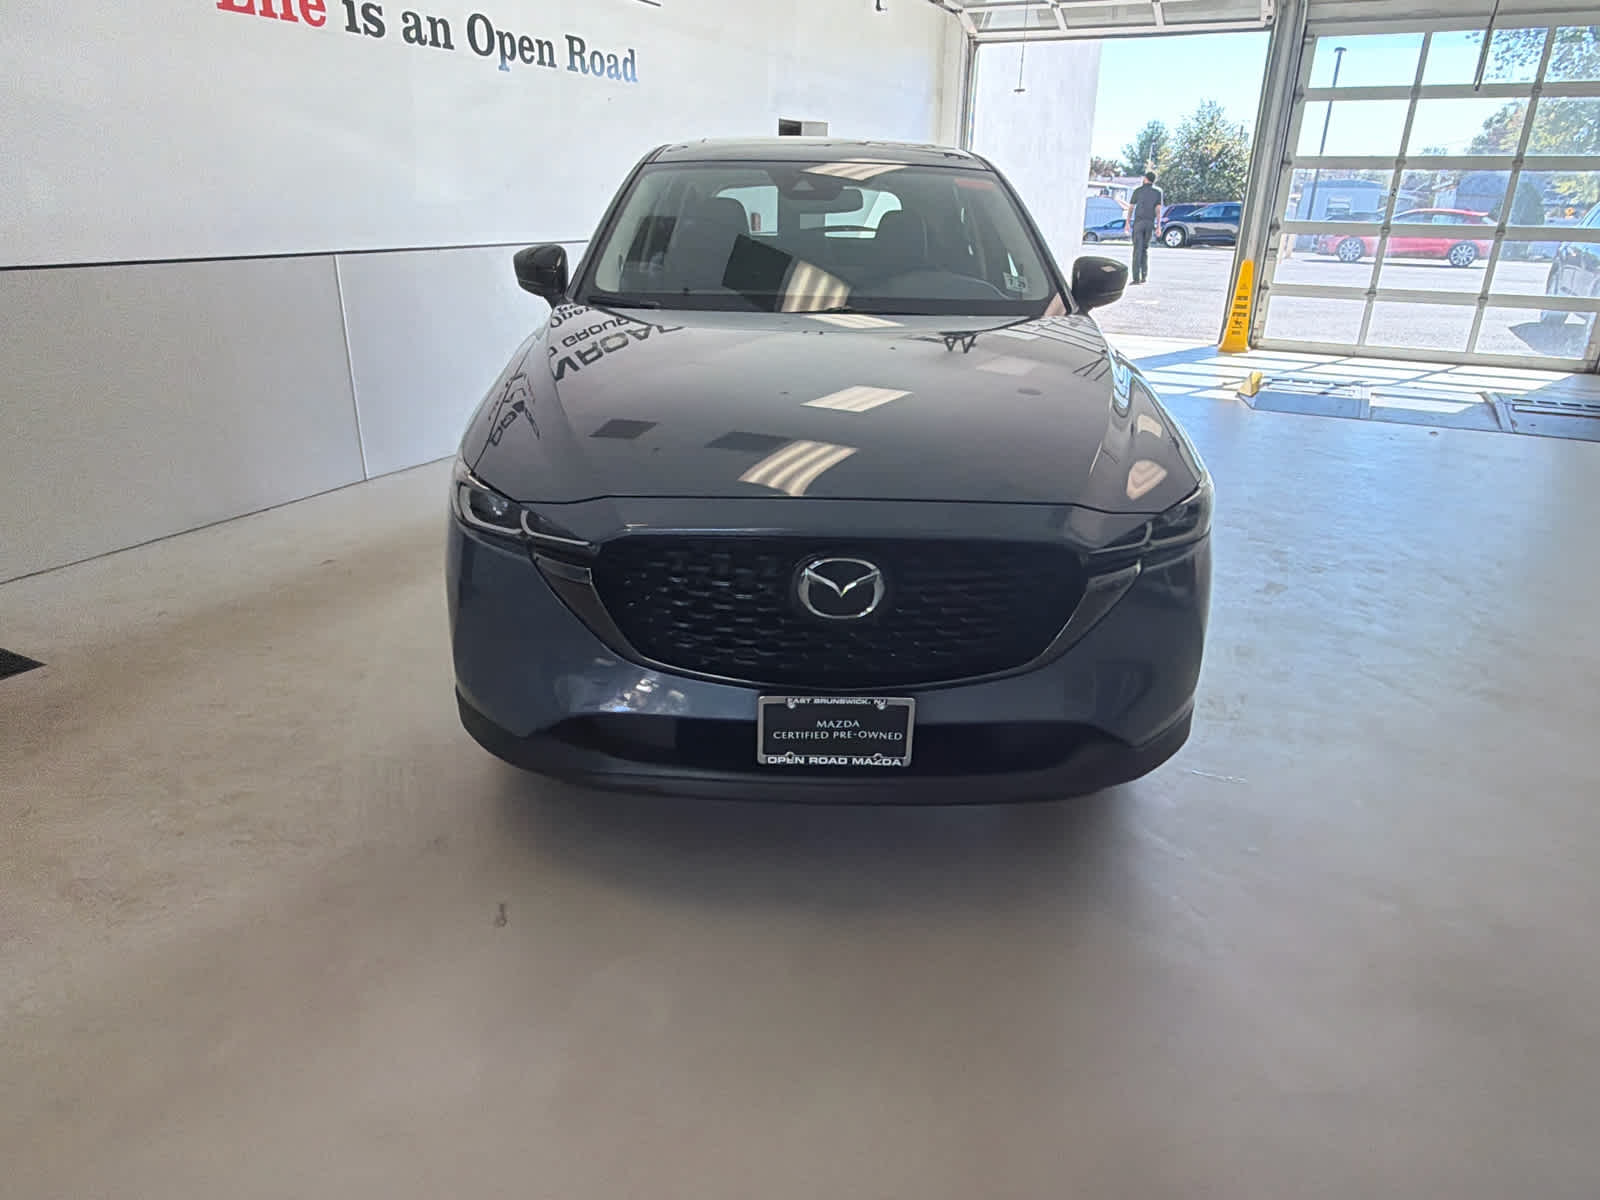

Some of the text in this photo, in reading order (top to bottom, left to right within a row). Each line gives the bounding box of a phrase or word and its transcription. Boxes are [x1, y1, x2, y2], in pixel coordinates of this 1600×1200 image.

[344, 0, 386, 38] is
[402, 10, 454, 50] an
[467, 13, 557, 71] Open
[565, 34, 639, 83] Road
[816, 720, 860, 729] MAZDA
[773, 731, 903, 741] CERTIFIED PRE-OWNED
[767, 756, 902, 767] OPEN ROAD MAZDA
